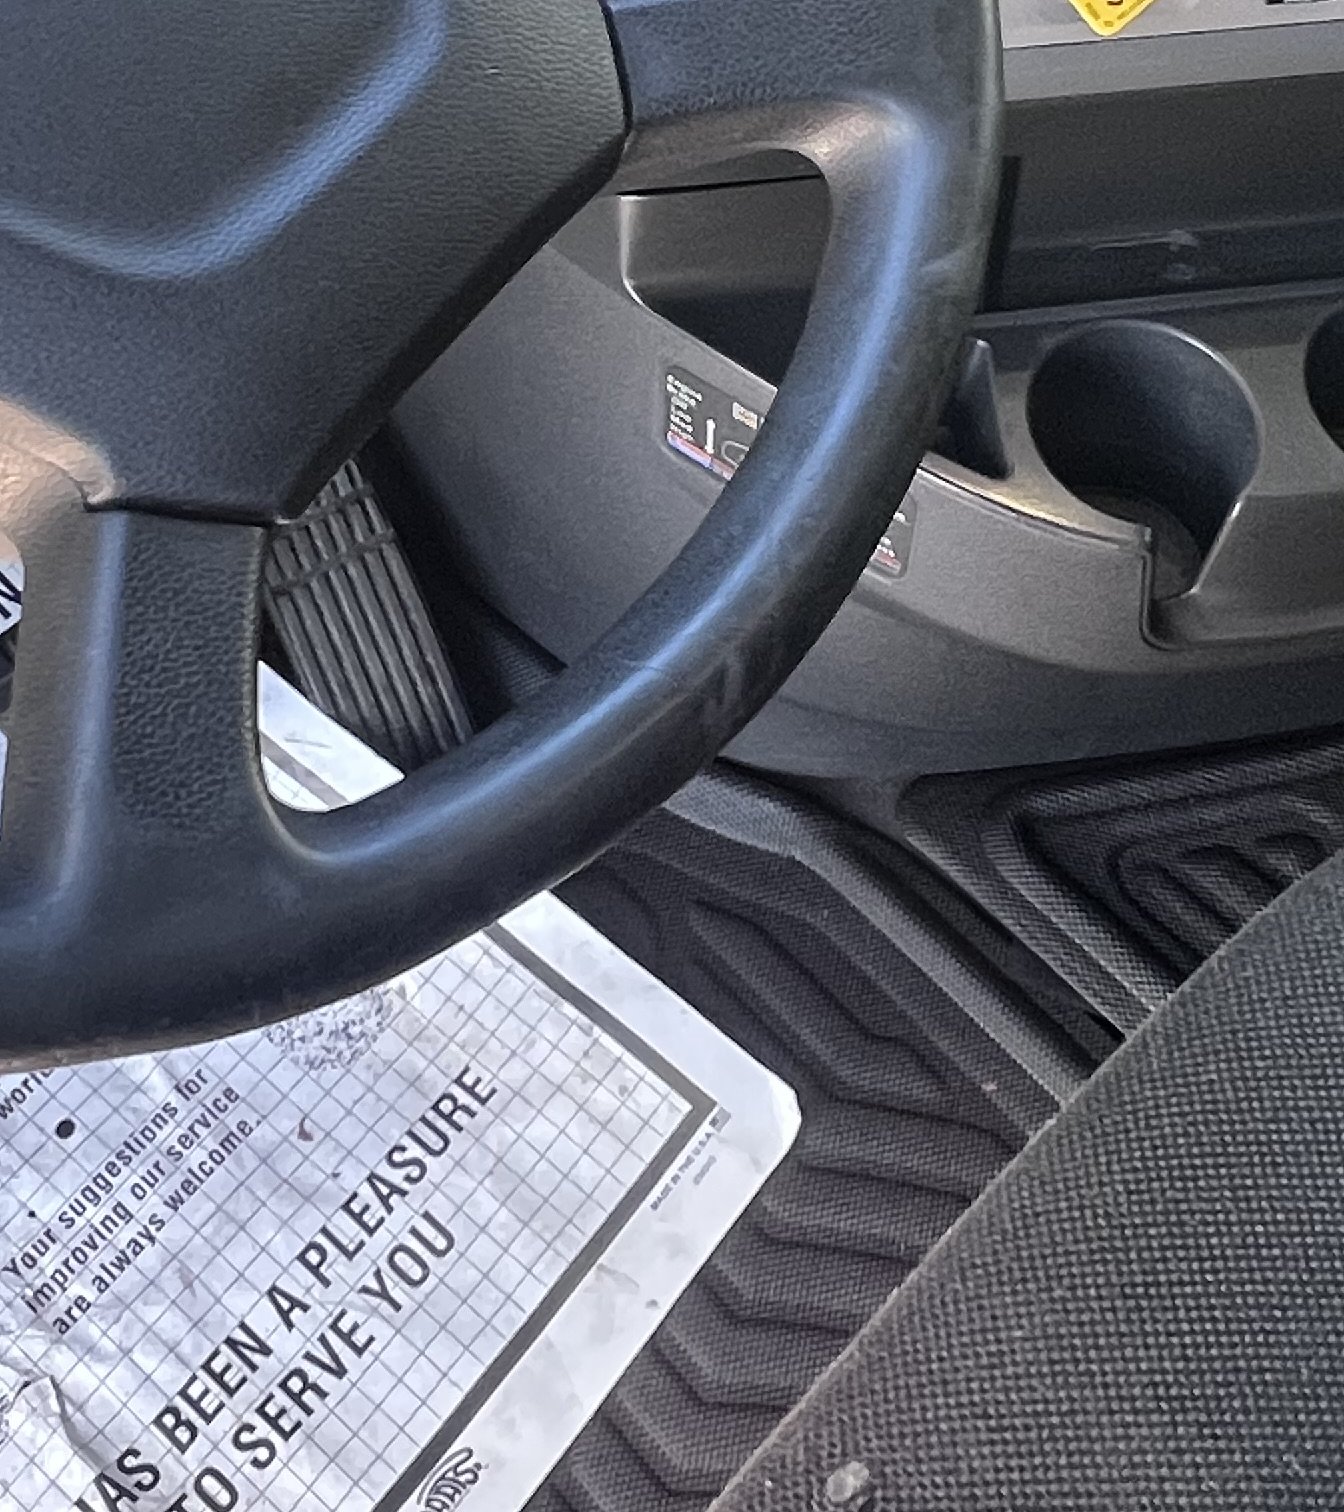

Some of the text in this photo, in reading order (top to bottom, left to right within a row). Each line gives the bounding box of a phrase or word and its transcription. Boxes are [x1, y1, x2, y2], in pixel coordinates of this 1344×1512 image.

[0, 1068, 209, 1278] Your suggestions for
[20, 1085, 241, 1315] improving our service
[51, 1294, 93, 1336] are
[91, 1212, 167, 1295] always
[74, 1064, 498, 1512] AS BEEN A PLEASURE
[232, 1308, 376, 1470] SERVE
[357, 1209, 456, 1314] YOU
